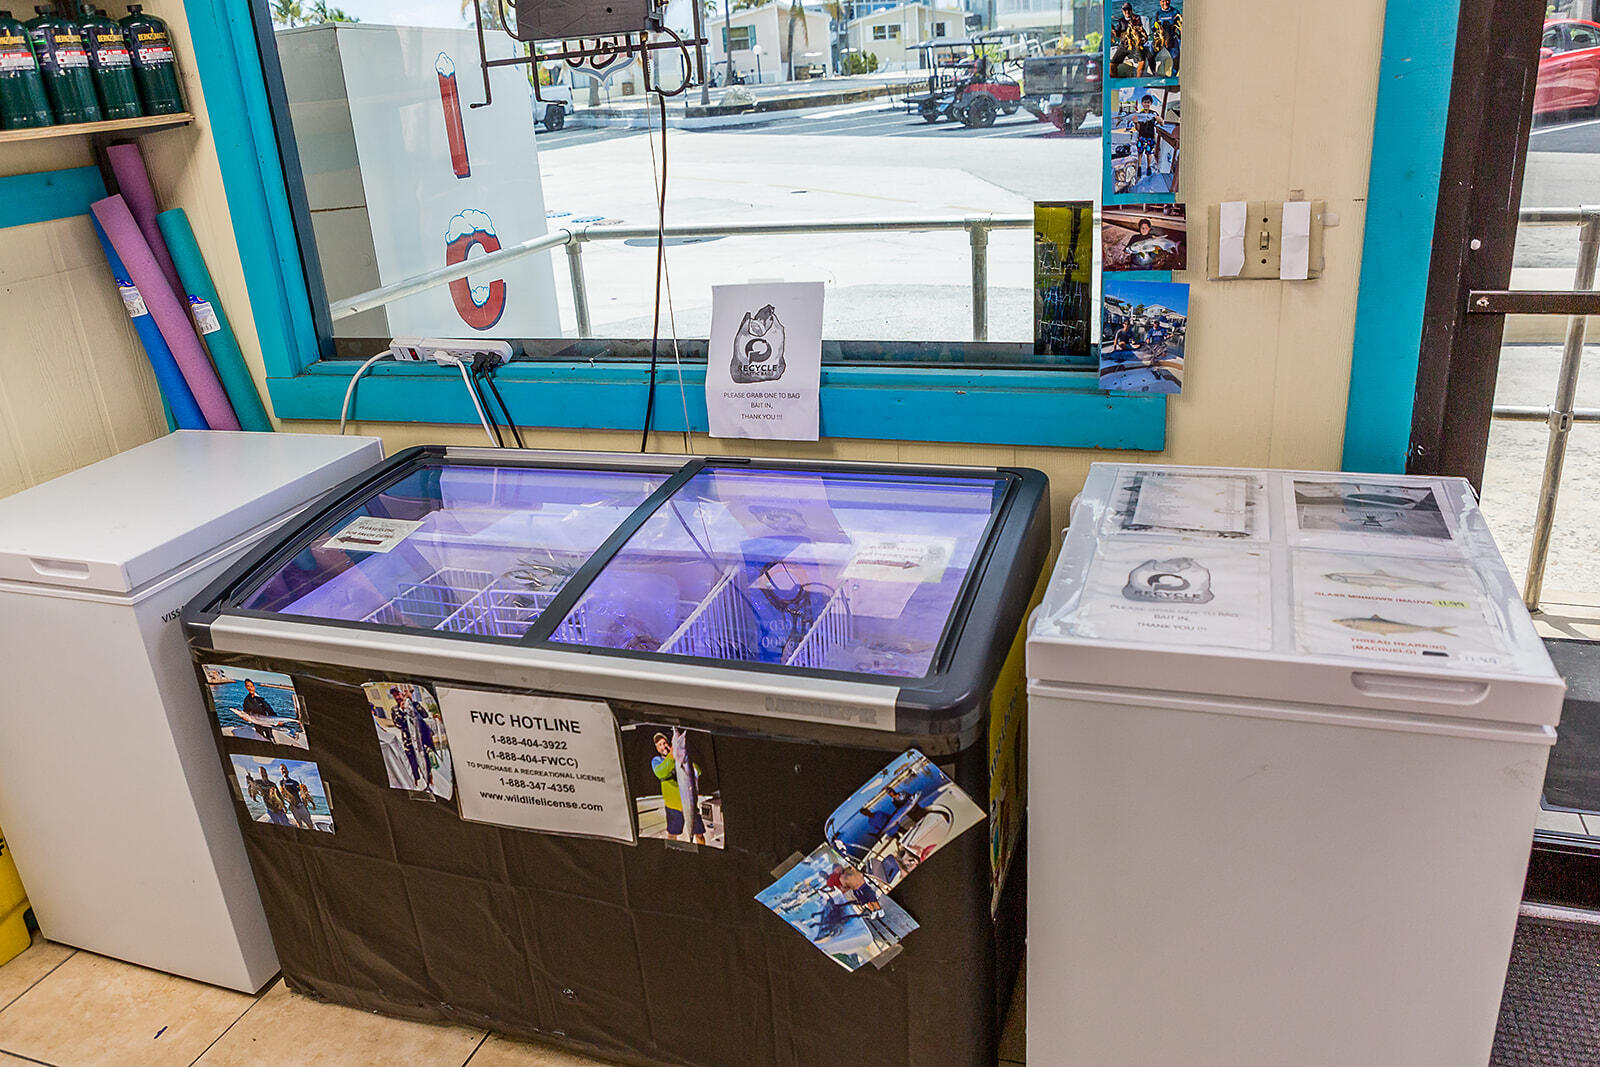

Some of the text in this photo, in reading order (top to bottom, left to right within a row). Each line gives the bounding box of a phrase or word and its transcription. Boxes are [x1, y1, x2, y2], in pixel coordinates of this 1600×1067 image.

[738, 364, 778, 372] RECYCLE
[1134, 590, 1201, 600] RECYCLE
[161, 605, 184, 623] VISS
[1137, 622, 1170, 630] THANK
[470, 710, 582, 734] FWC HOTLINE
[491, 735, 568, 750] 1-888-404-3922
[486, 750, 579, 769] (1-888-404-FWCC)
[477, 763, 513, 773] PURCHASE
[520, 768, 575, 780] RECREATIONAL
[576, 773, 606, 783] LICENSE
[499, 778, 576, 793] 1-888-347-4356
[480, 791, 604, 811] www.wildlifelicense.com
